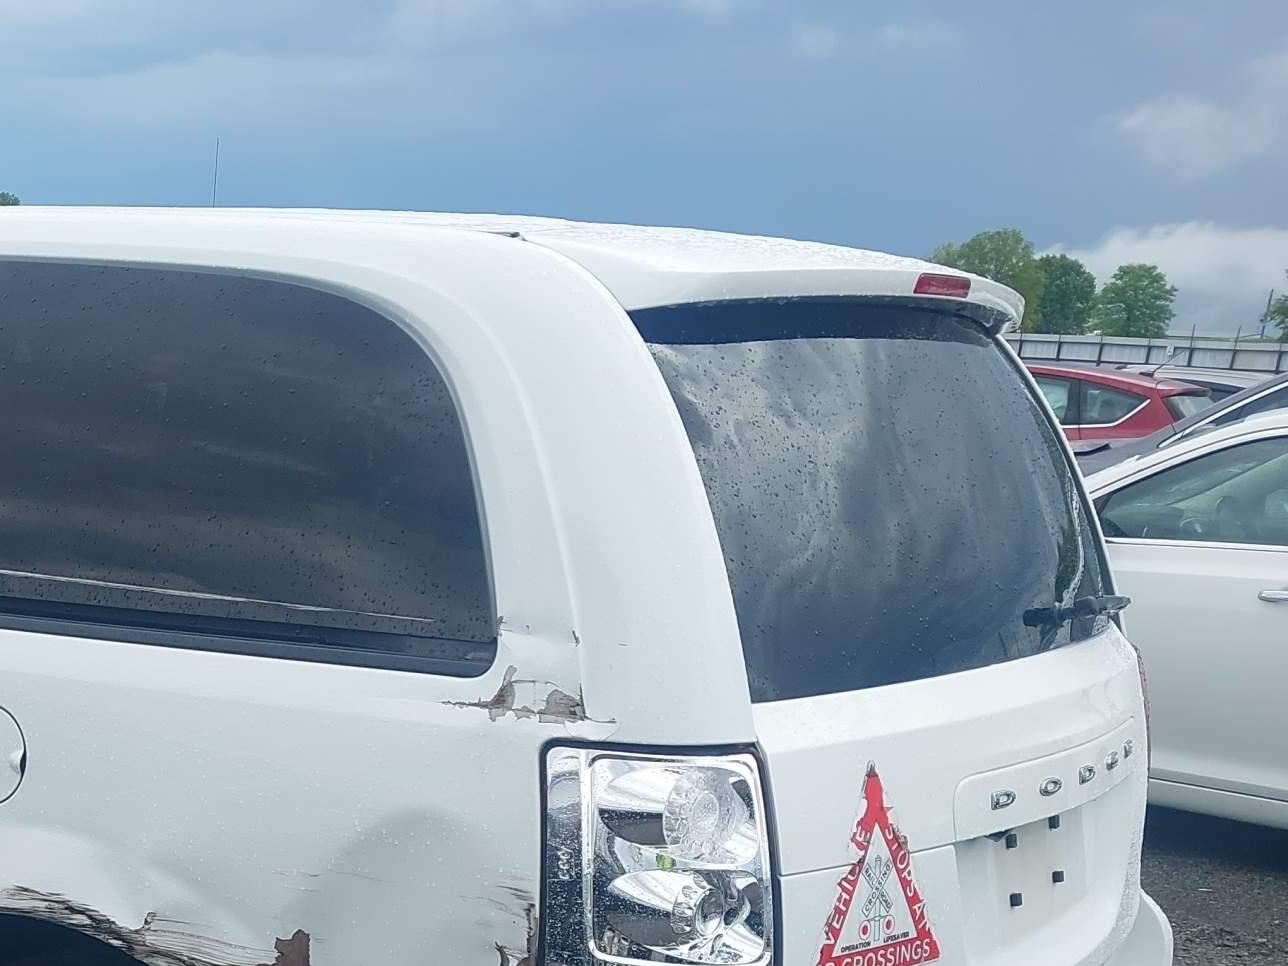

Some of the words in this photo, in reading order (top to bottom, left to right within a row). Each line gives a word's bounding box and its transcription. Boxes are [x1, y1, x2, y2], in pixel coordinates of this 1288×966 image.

[990, 739, 1135, 811] DODGE
[864, 862, 892, 912] CROSSING
[841, 941, 871, 953] OPERATION
[883, 931, 910, 943] LIFESAVER
